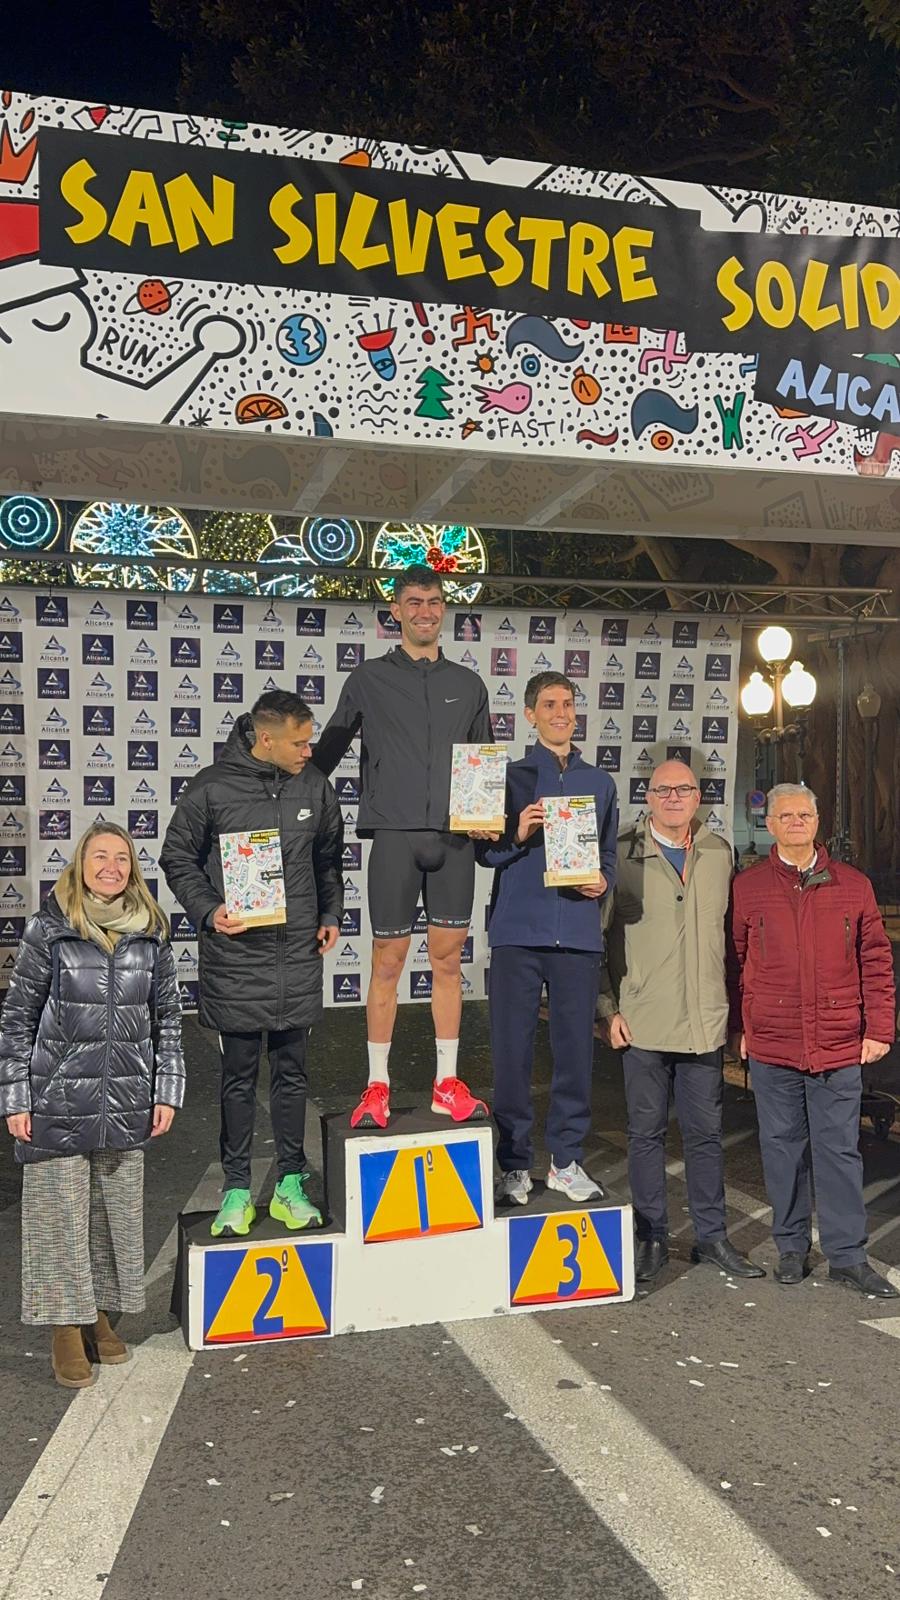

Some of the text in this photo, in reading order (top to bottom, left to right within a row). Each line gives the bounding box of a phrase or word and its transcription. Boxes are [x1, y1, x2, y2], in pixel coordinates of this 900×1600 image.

[60, 158, 900, 331] SAN SILVESTRE SOLID
[98, 325, 159, 368] RUN
[775, 358, 900, 424] ALICA
[497, 417, 564, 439] FAST!
[252, 1250, 288, 1336] 2º
[556, 1217, 588, 1298] 3º
